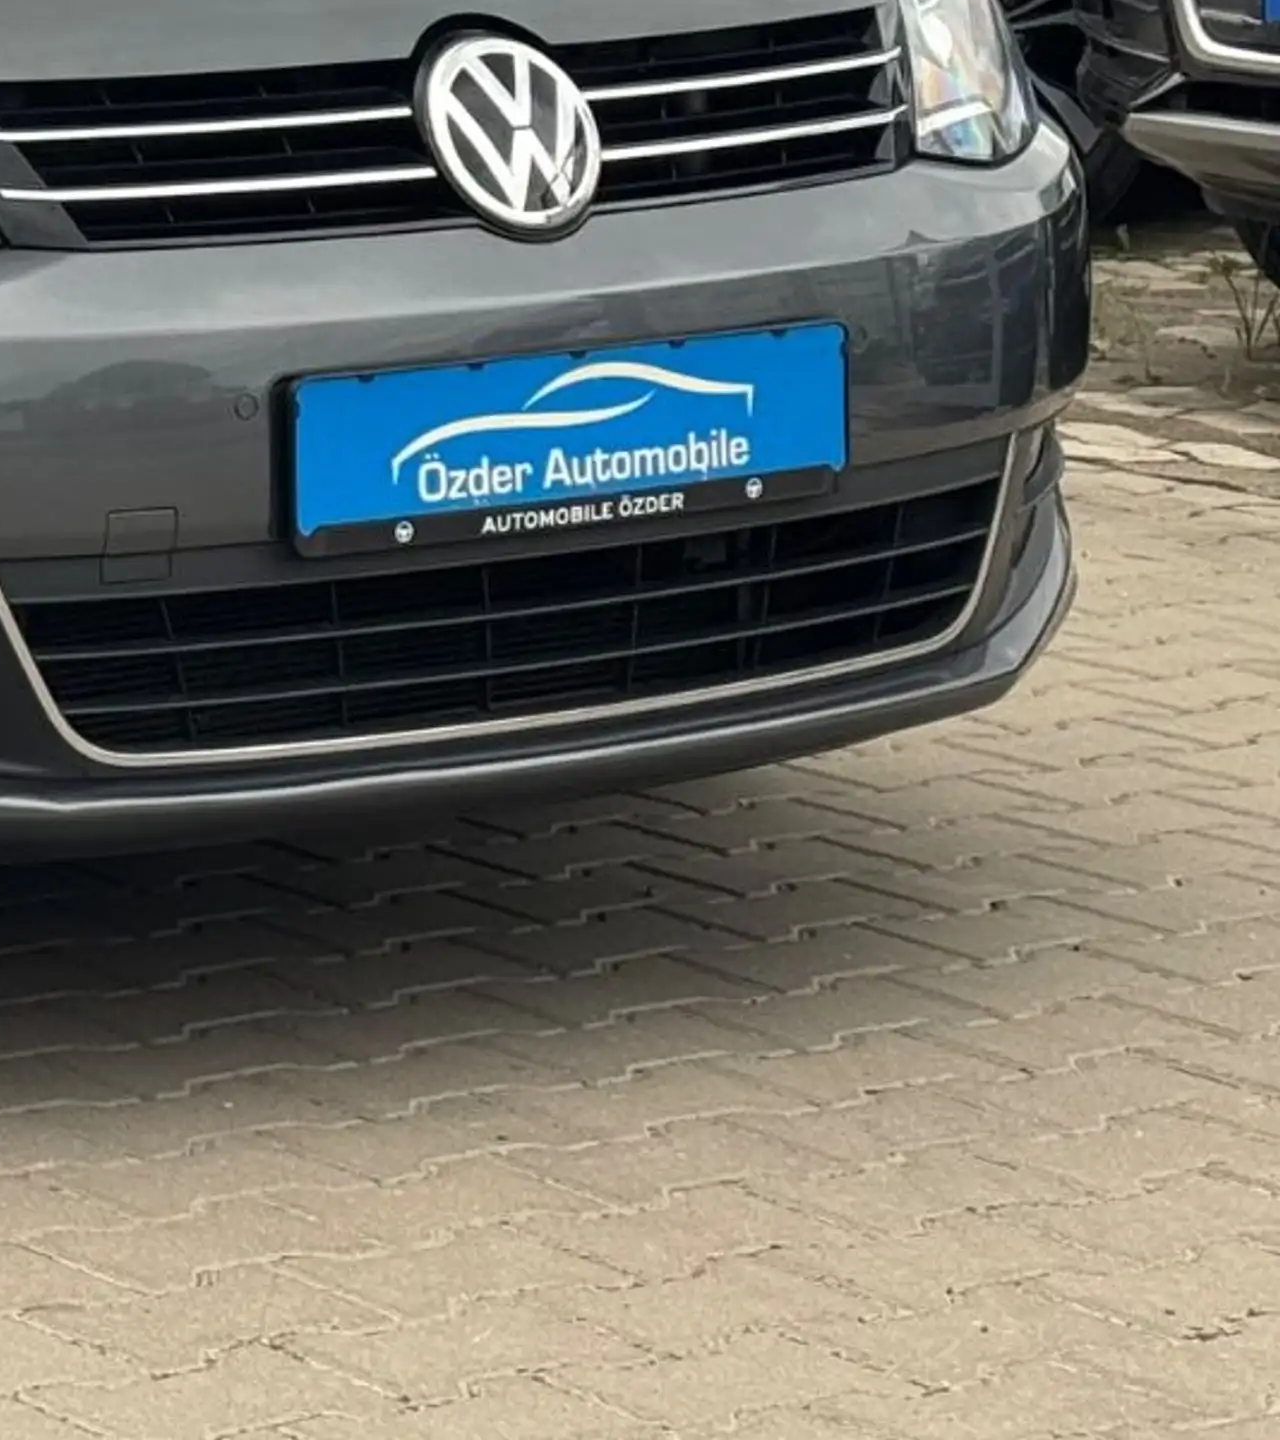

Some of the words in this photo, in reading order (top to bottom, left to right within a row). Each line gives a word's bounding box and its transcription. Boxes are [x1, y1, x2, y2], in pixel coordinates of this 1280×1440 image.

[417, 452, 533, 504] Özder
[542, 426, 750, 490] Automobile
[481, 502, 613, 536] AUTOMOBILE
[618, 491, 685, 518] ÖZDER
